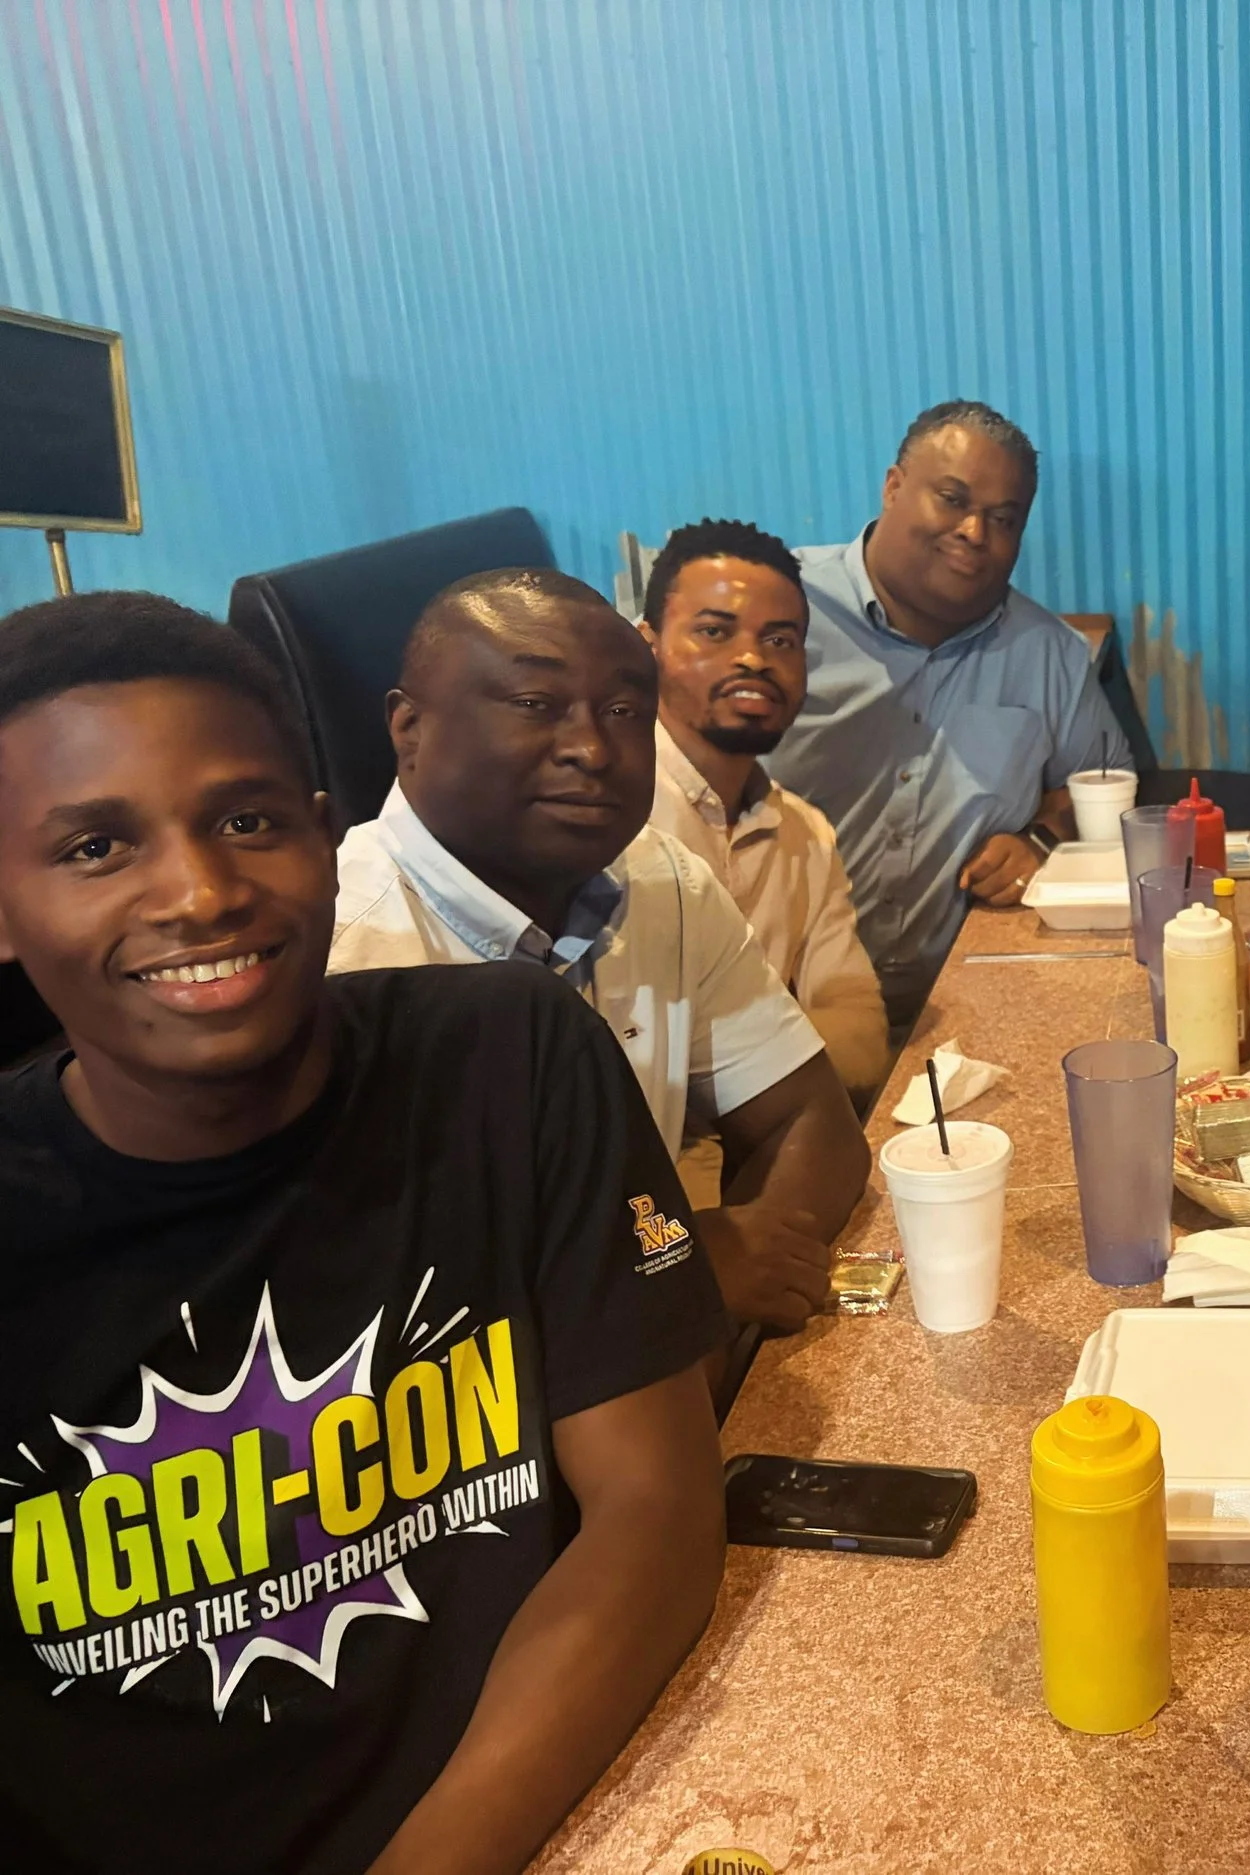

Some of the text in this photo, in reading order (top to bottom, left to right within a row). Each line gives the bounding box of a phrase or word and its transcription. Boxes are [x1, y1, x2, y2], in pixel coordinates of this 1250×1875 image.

[12, 1317, 520, 1635] AGRI-CON
[33, 1460, 540, 1676] UNVEILING THE SUPERHERO WITHIN
